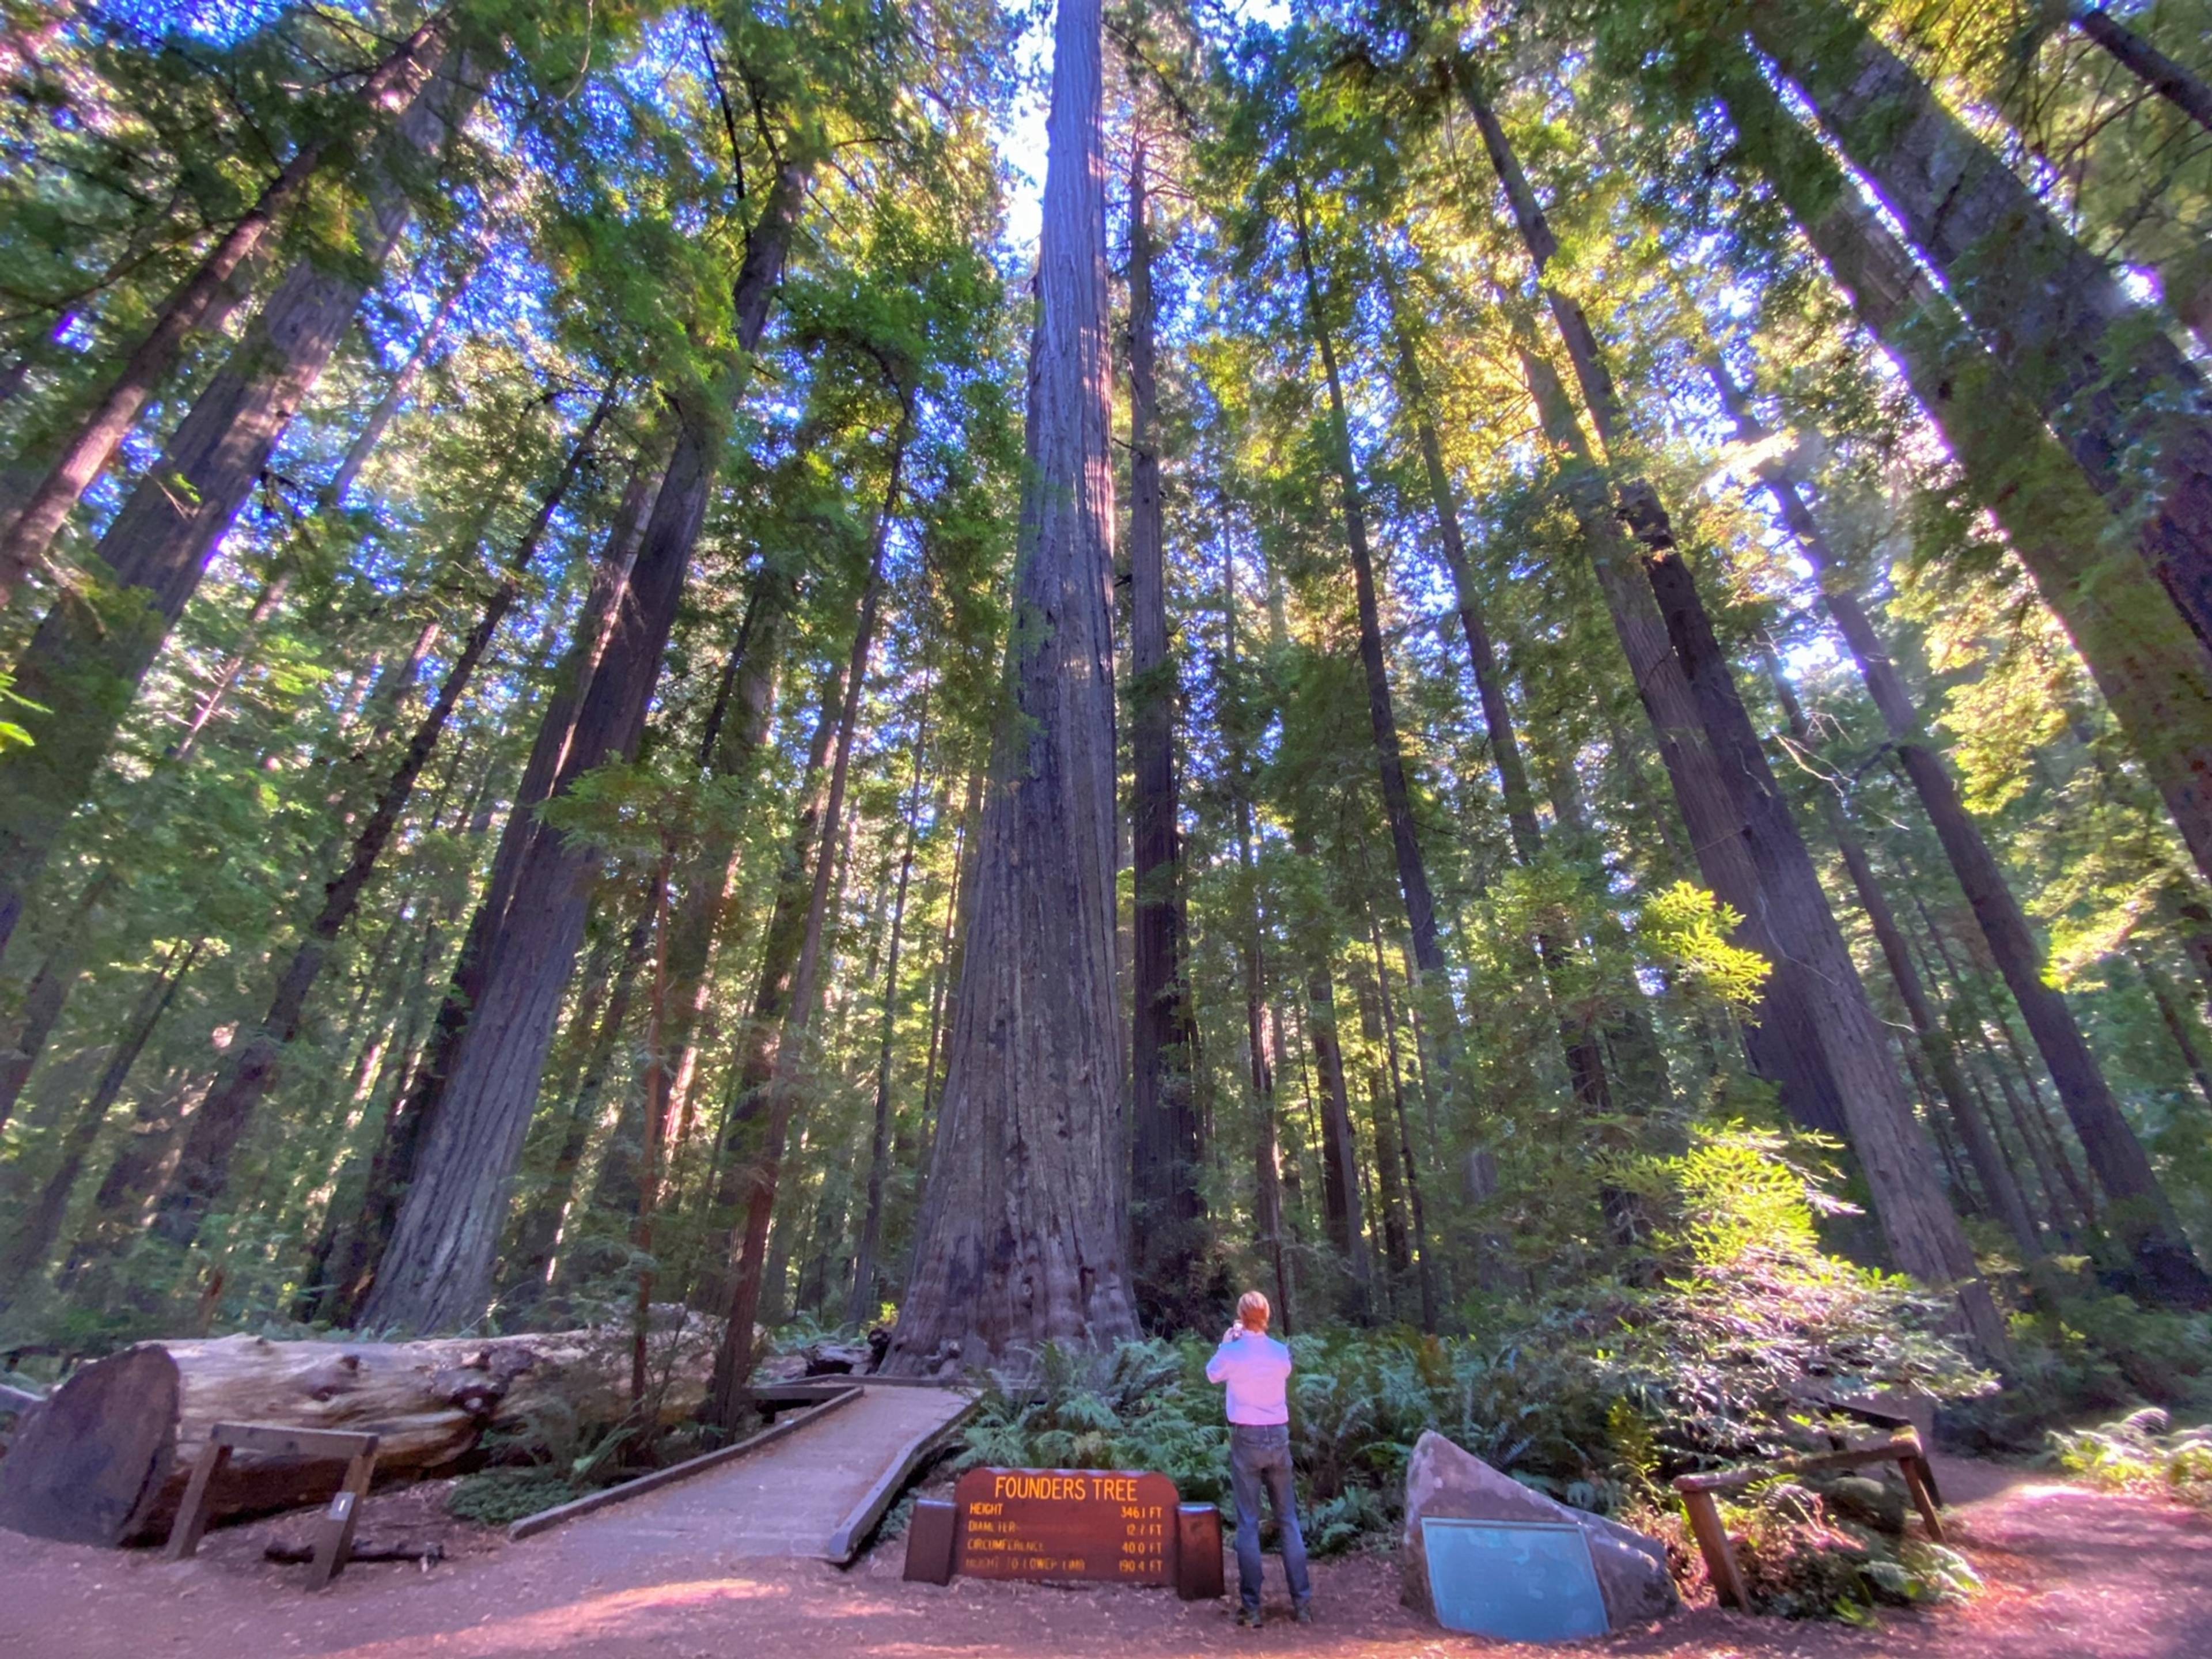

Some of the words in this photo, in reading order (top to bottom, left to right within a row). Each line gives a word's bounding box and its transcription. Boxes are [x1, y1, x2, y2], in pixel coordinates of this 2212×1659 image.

[995, 1476, 1085, 1500] FOUNDERS
[1093, 1479, 1138, 1501] TREE
[970, 1502, 1003, 1516] HEIGHT
[1150, 1506, 1162, 1519] FT
[1150, 1524, 1162, 1536] FT
[1122, 1541, 1145, 1555] 400
[1119, 1559, 1145, 1572] 1904
[1150, 1559, 1162, 1573] FT
